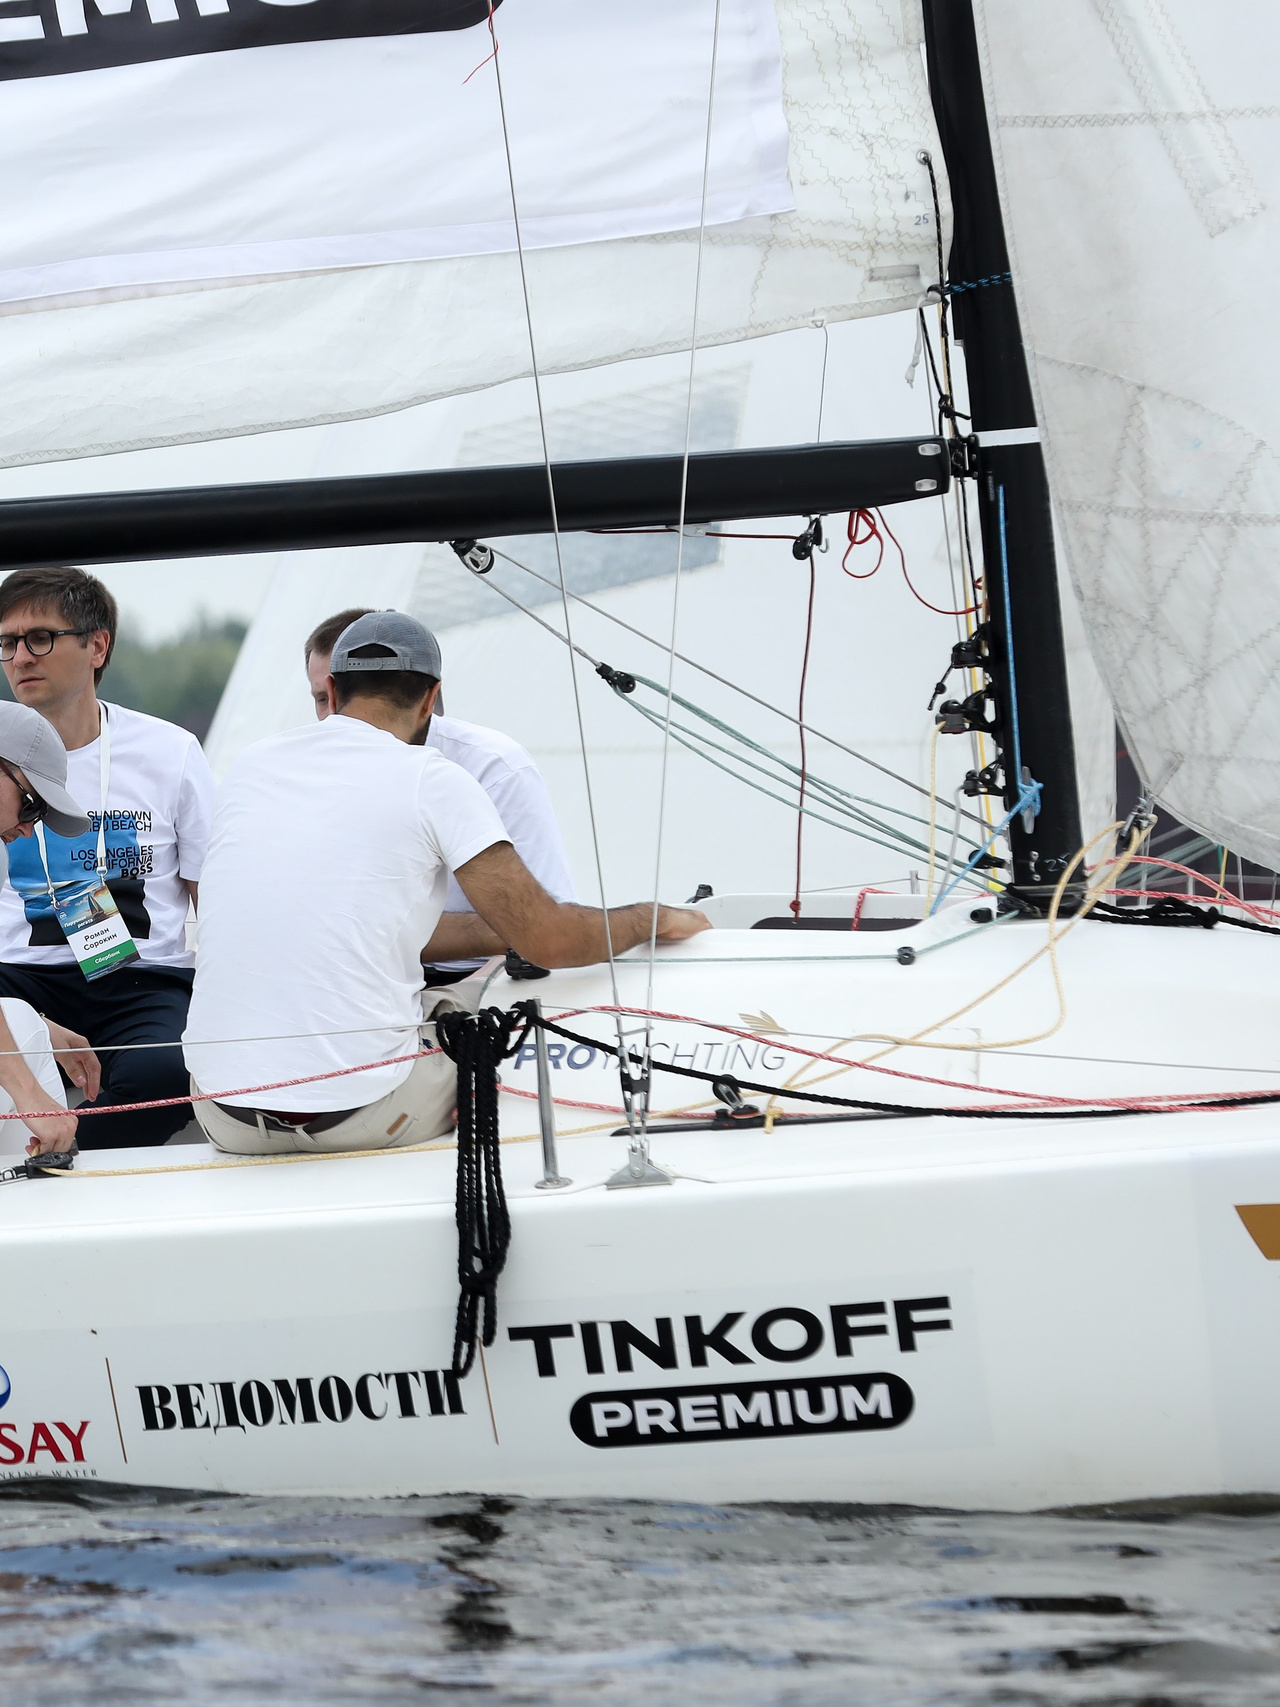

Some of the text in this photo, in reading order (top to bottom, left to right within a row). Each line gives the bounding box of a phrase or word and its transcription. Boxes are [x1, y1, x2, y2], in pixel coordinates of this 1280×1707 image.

[111, 820, 152, 832] BEACH
[70, 845, 154, 861] LOS NGELES
[83, 854, 153, 871] CAIFORNIA
[121, 862, 153, 878] BOSS
[83, 933, 118, 951] Сорокин
[84, 927, 110, 942] Роман
[508, 1297, 953, 1378] TINKOFF
[136, 1369, 469, 1435] ВЕДОМОСТИ
[591, 1382, 894, 1437] PREMIUM
[51, 1469, 99, 1479] WATER
